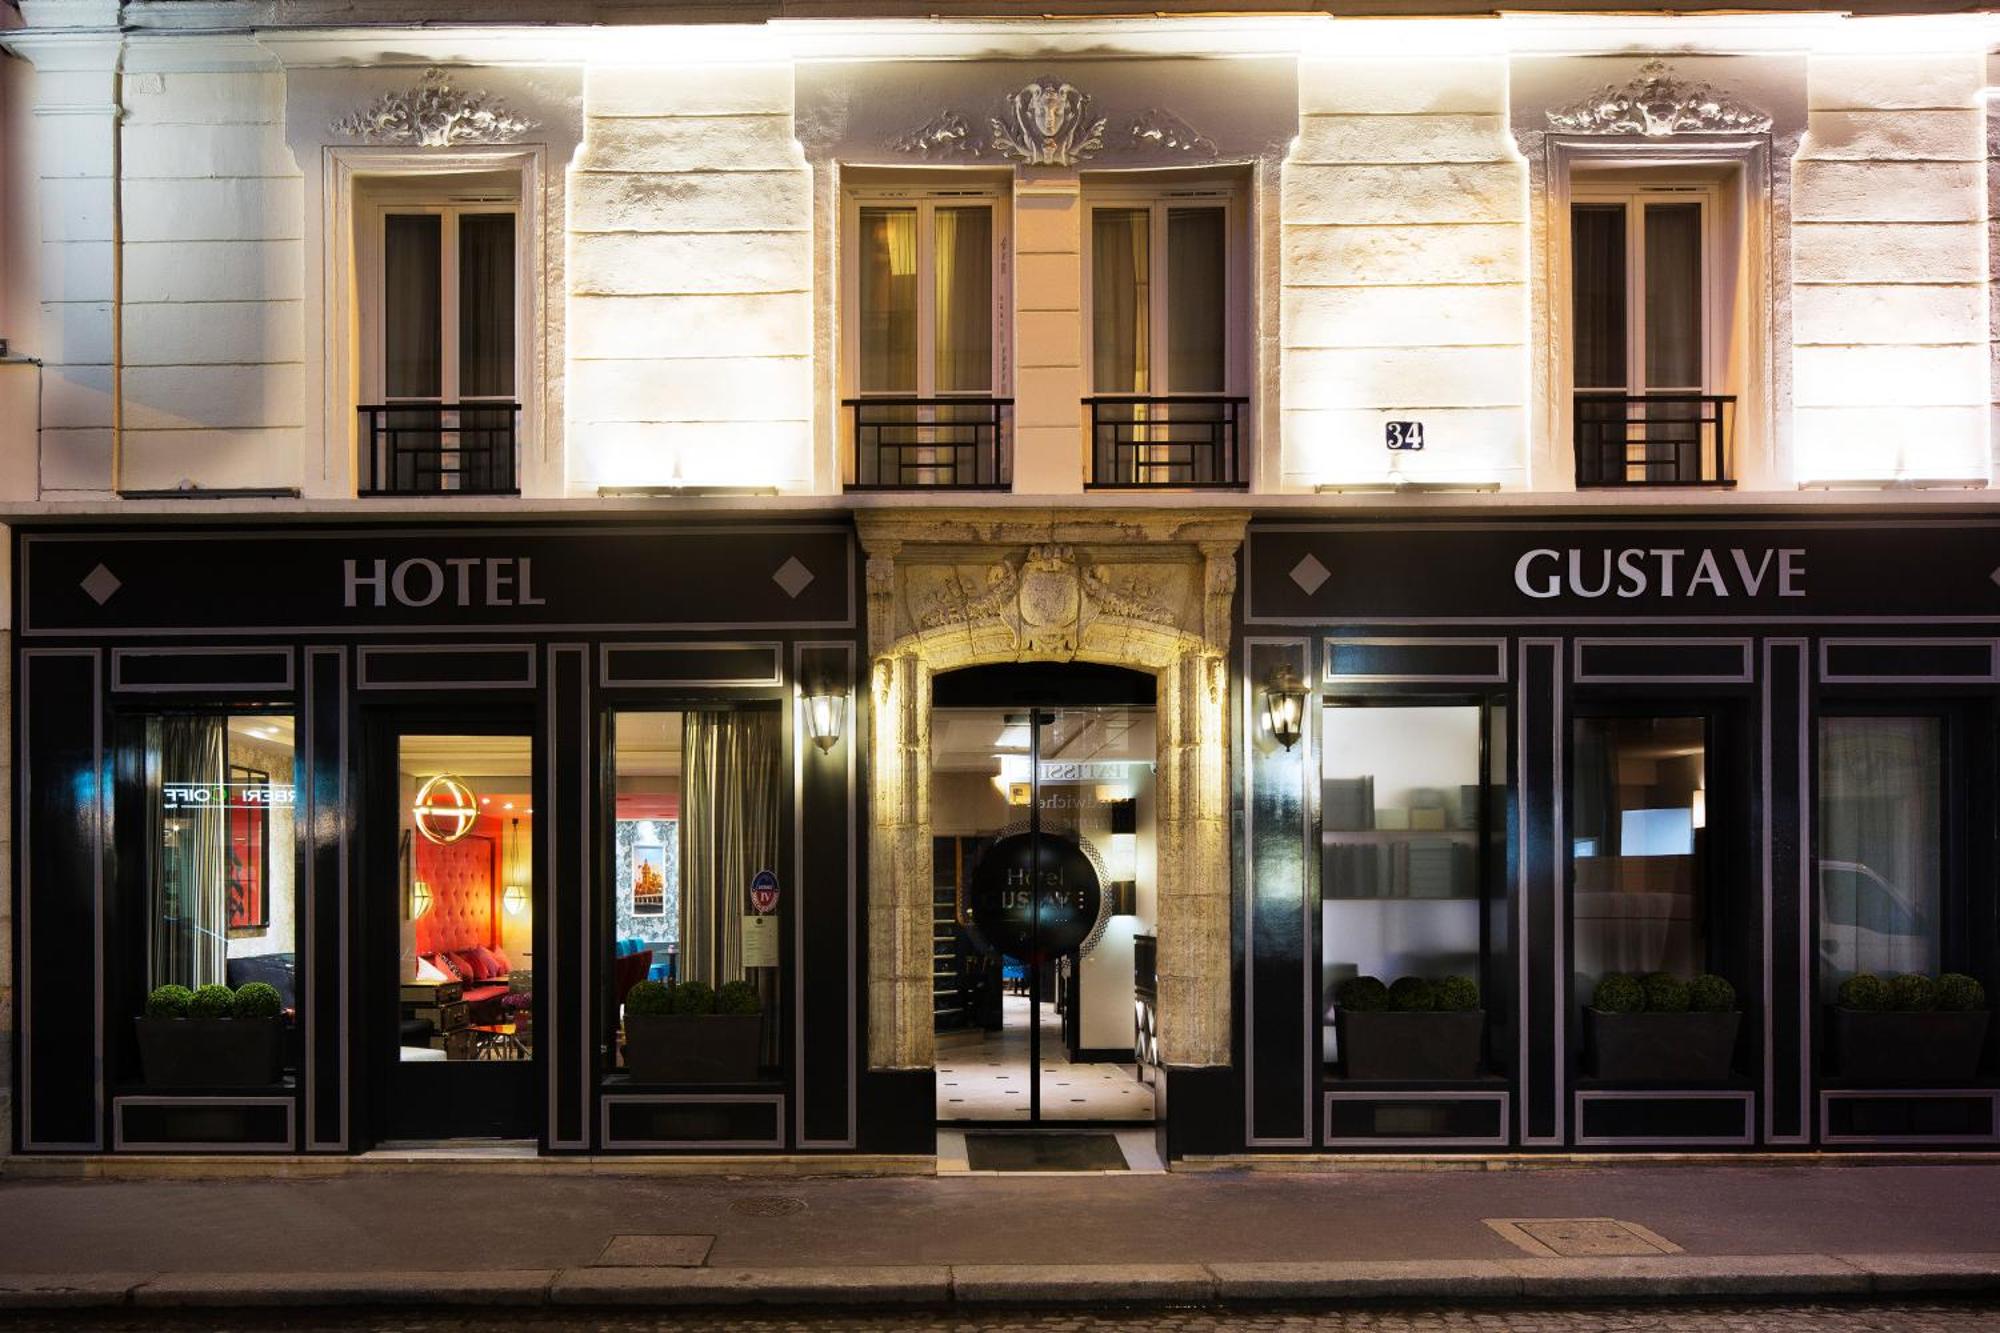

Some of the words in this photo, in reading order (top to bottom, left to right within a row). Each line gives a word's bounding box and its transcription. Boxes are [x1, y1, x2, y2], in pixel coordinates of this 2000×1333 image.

[1387, 422, 1422, 449] 34
[343, 556, 547, 607] HOTEL
[1513, 548, 1807, 599] GUSTAVE
